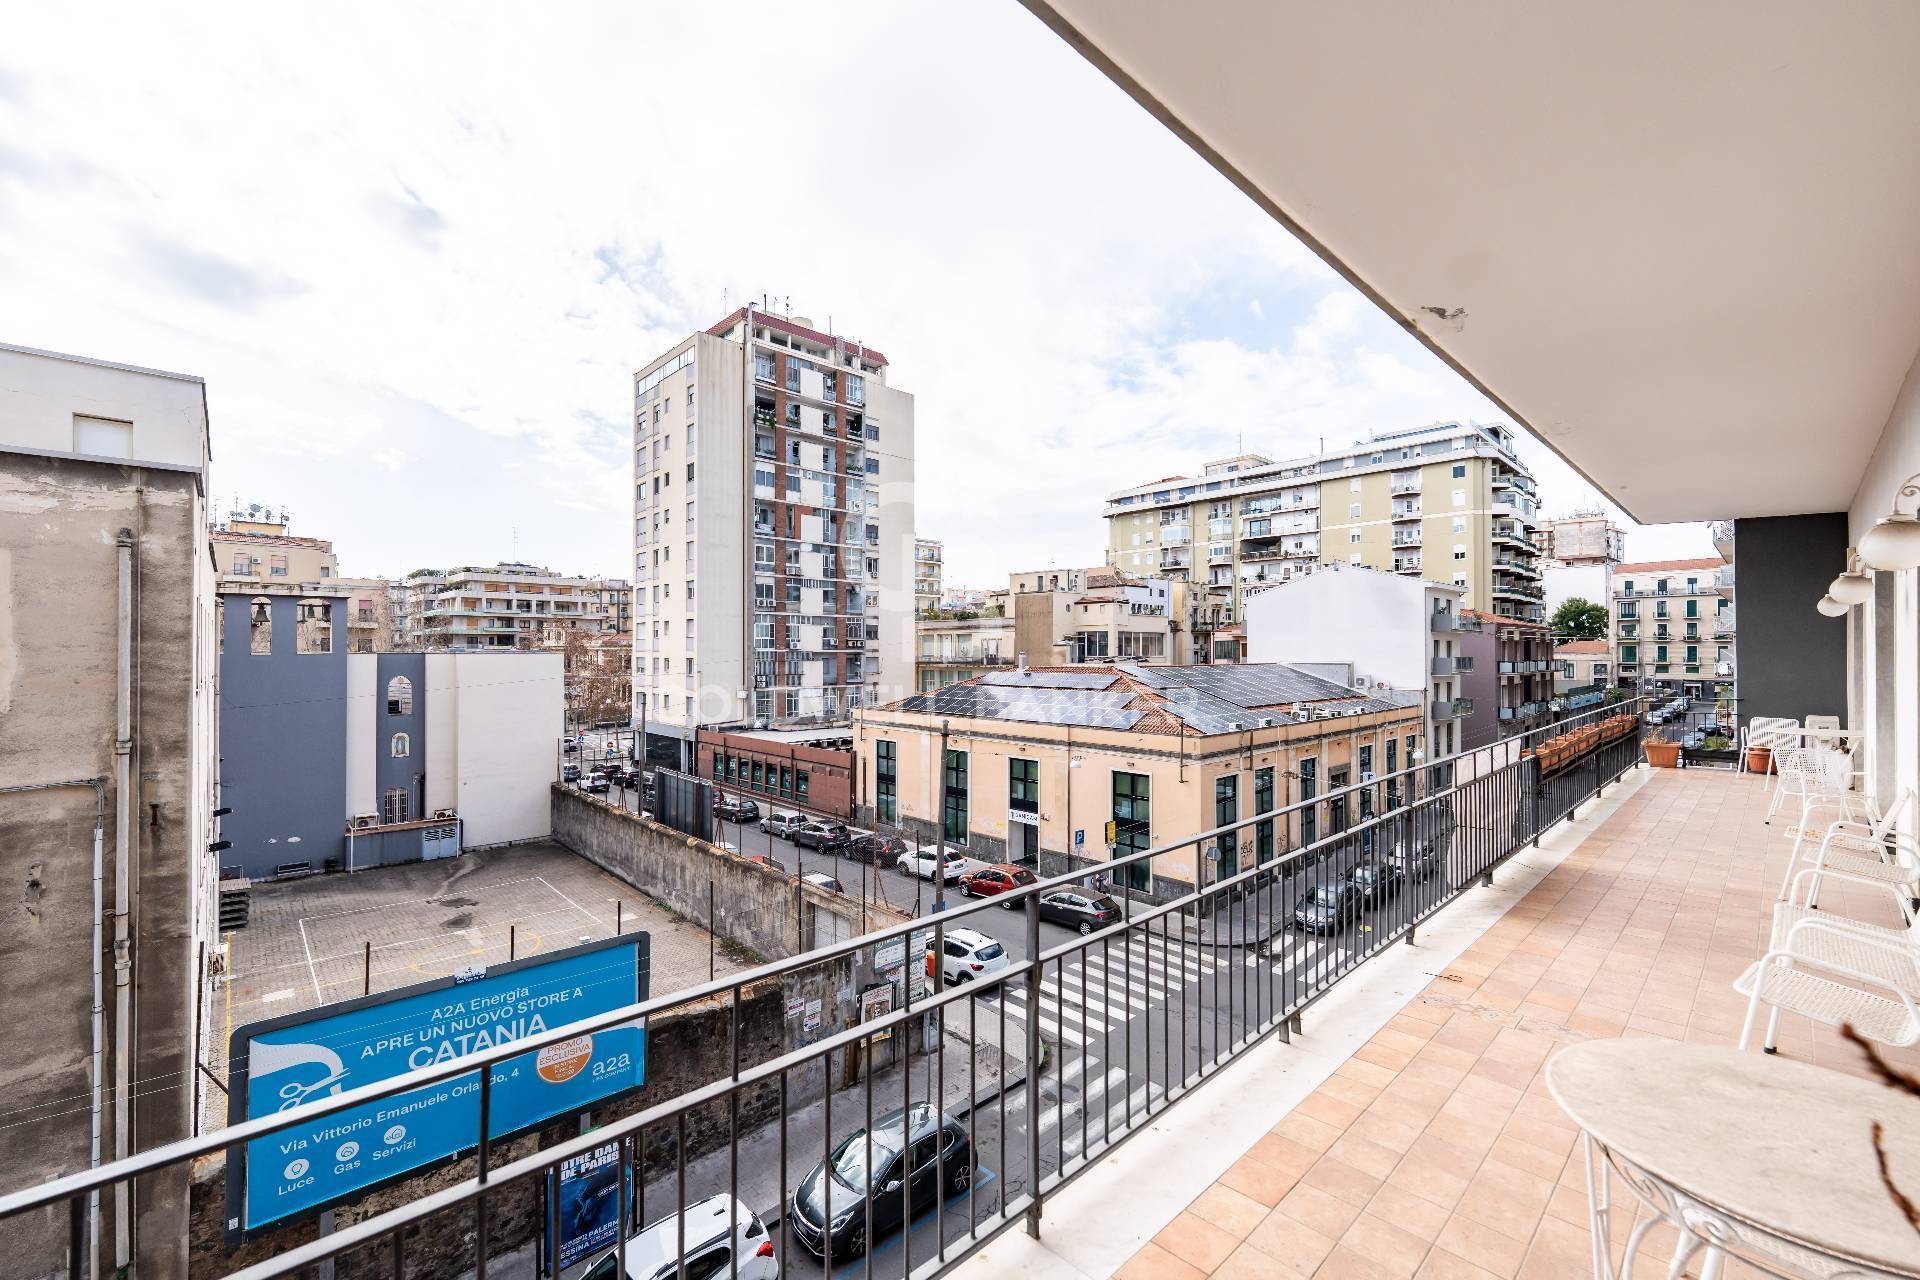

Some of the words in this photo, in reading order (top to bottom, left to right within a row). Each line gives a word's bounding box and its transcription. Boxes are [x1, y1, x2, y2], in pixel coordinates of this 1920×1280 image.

[1076, 831, 1083, 844] P
[431, 1003, 466, 1022] A2A
[470, 986, 529, 1011] Energia
[360, 1033, 414, 1060] APRE
[419, 1024, 445, 1042] UN
[450, 1006, 514, 1033] NUOVO
[517, 990, 569, 1014] STORE
[572, 987, 583, 999] A
[408, 1013, 548, 1070] CATANIA
[546, 1037, 583, 1055] PROMO
[539, 1043, 591, 1066] ESCLUSIVA
[592, 1053, 631, 1076] a2a
[279, 1139, 308, 1155] Via
[312, 1118, 372, 1144] Vittorio
[376, 1092, 448, 1123] Emanuele
[511, 1067, 519, 1078] 4
[372, 1137, 416, 1161] Servizi
[333, 1159, 361, 1175] Gas
[560, 1169, 577, 1181] DE
[580, 1150, 619, 1174] PARIS
[277, 1175, 315, 1196] Luce
[588, 1218, 620, 1239] PALERM
[560, 1241, 590, 1260] ESSINA
